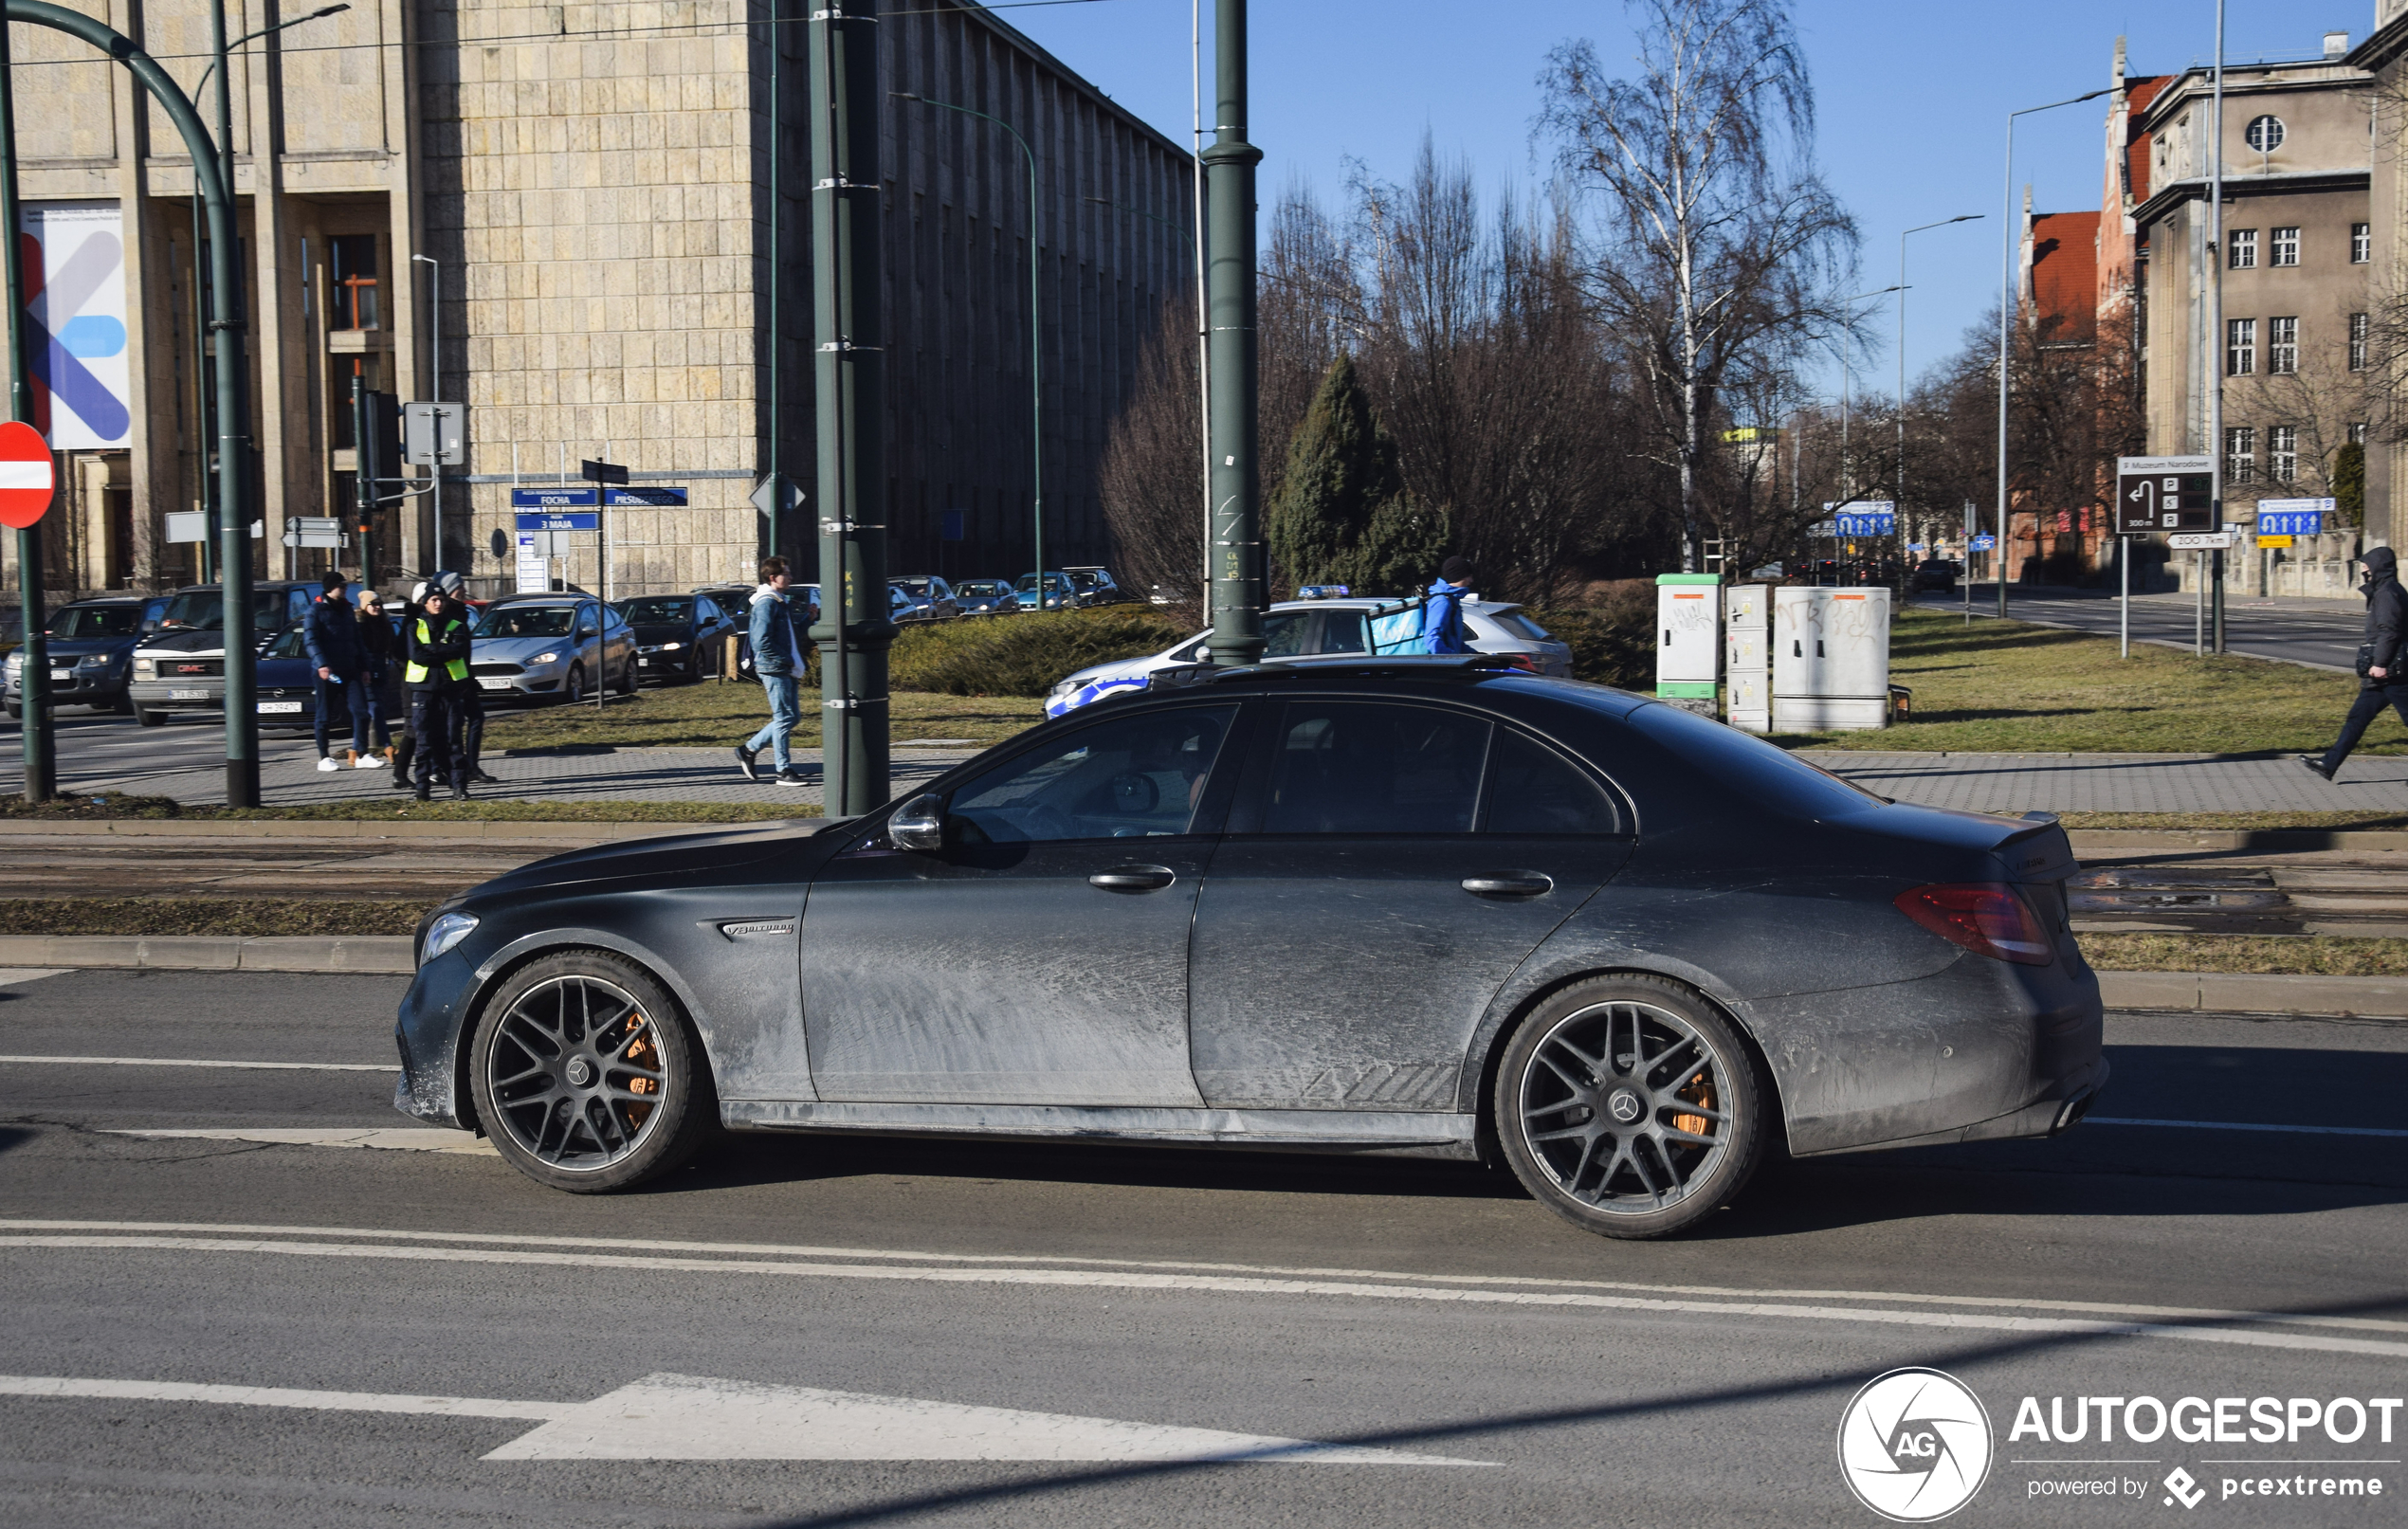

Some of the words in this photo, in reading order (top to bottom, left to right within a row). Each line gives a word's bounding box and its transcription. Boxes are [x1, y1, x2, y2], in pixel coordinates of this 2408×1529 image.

[2167, 460, 2209, 468] Narodowe
[2167, 480, 2174, 488] P
[540, 496, 571, 504] FOCHA
[2167, 516, 2174, 524] R
[541, 520, 548, 529] 3
[549, 520, 574, 529] MAJA
[2178, 537, 2200, 545] ZOO
[177, 664, 206, 673] GMC
[727, 926, 748, 935] V8
